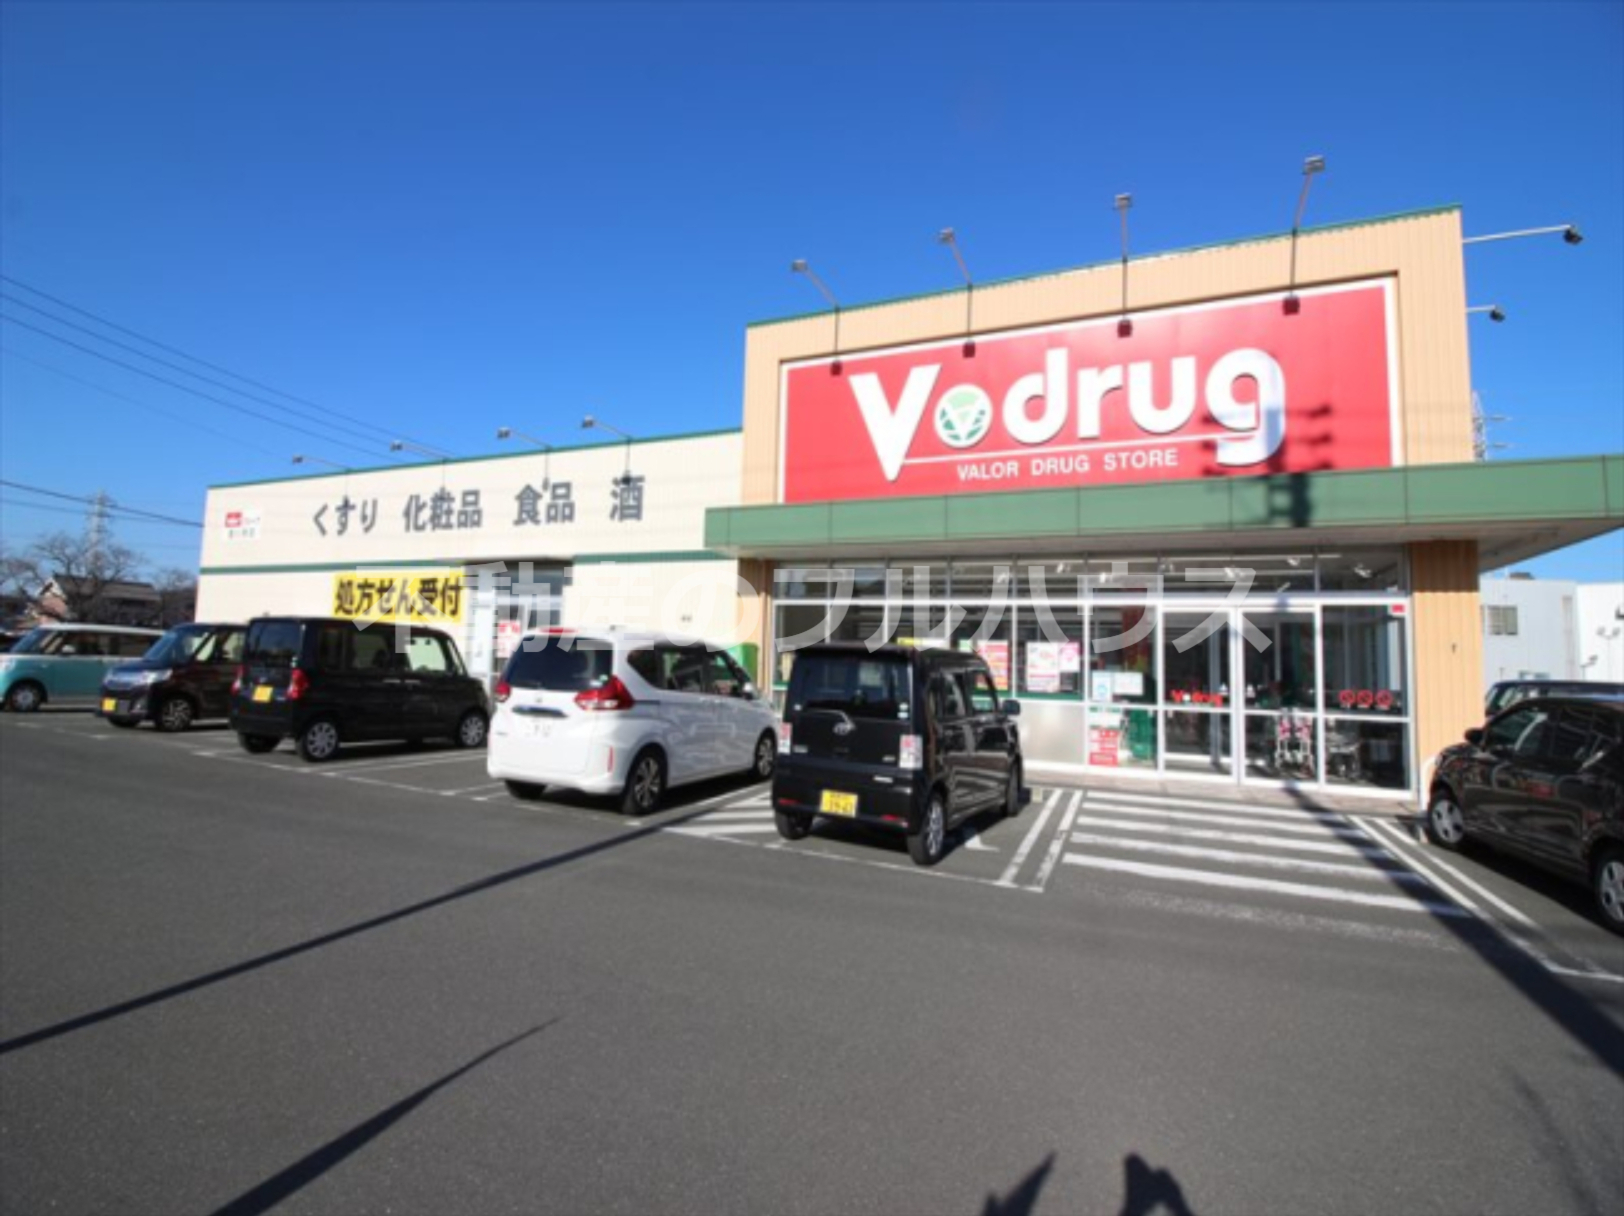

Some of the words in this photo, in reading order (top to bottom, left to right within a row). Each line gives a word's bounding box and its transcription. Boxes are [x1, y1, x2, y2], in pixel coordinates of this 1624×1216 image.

[957, 460, 1019, 481] VALOR
[1031, 454, 1090, 476] DRUG
[1103, 449, 1178, 471] STORE
[313, 495, 378, 536] くすり
[402, 488, 483, 533] 化粧品
[513, 482, 575, 526] 食品
[609, 475, 645, 521] 酒
[334, 574, 464, 616] 処方せん受付
